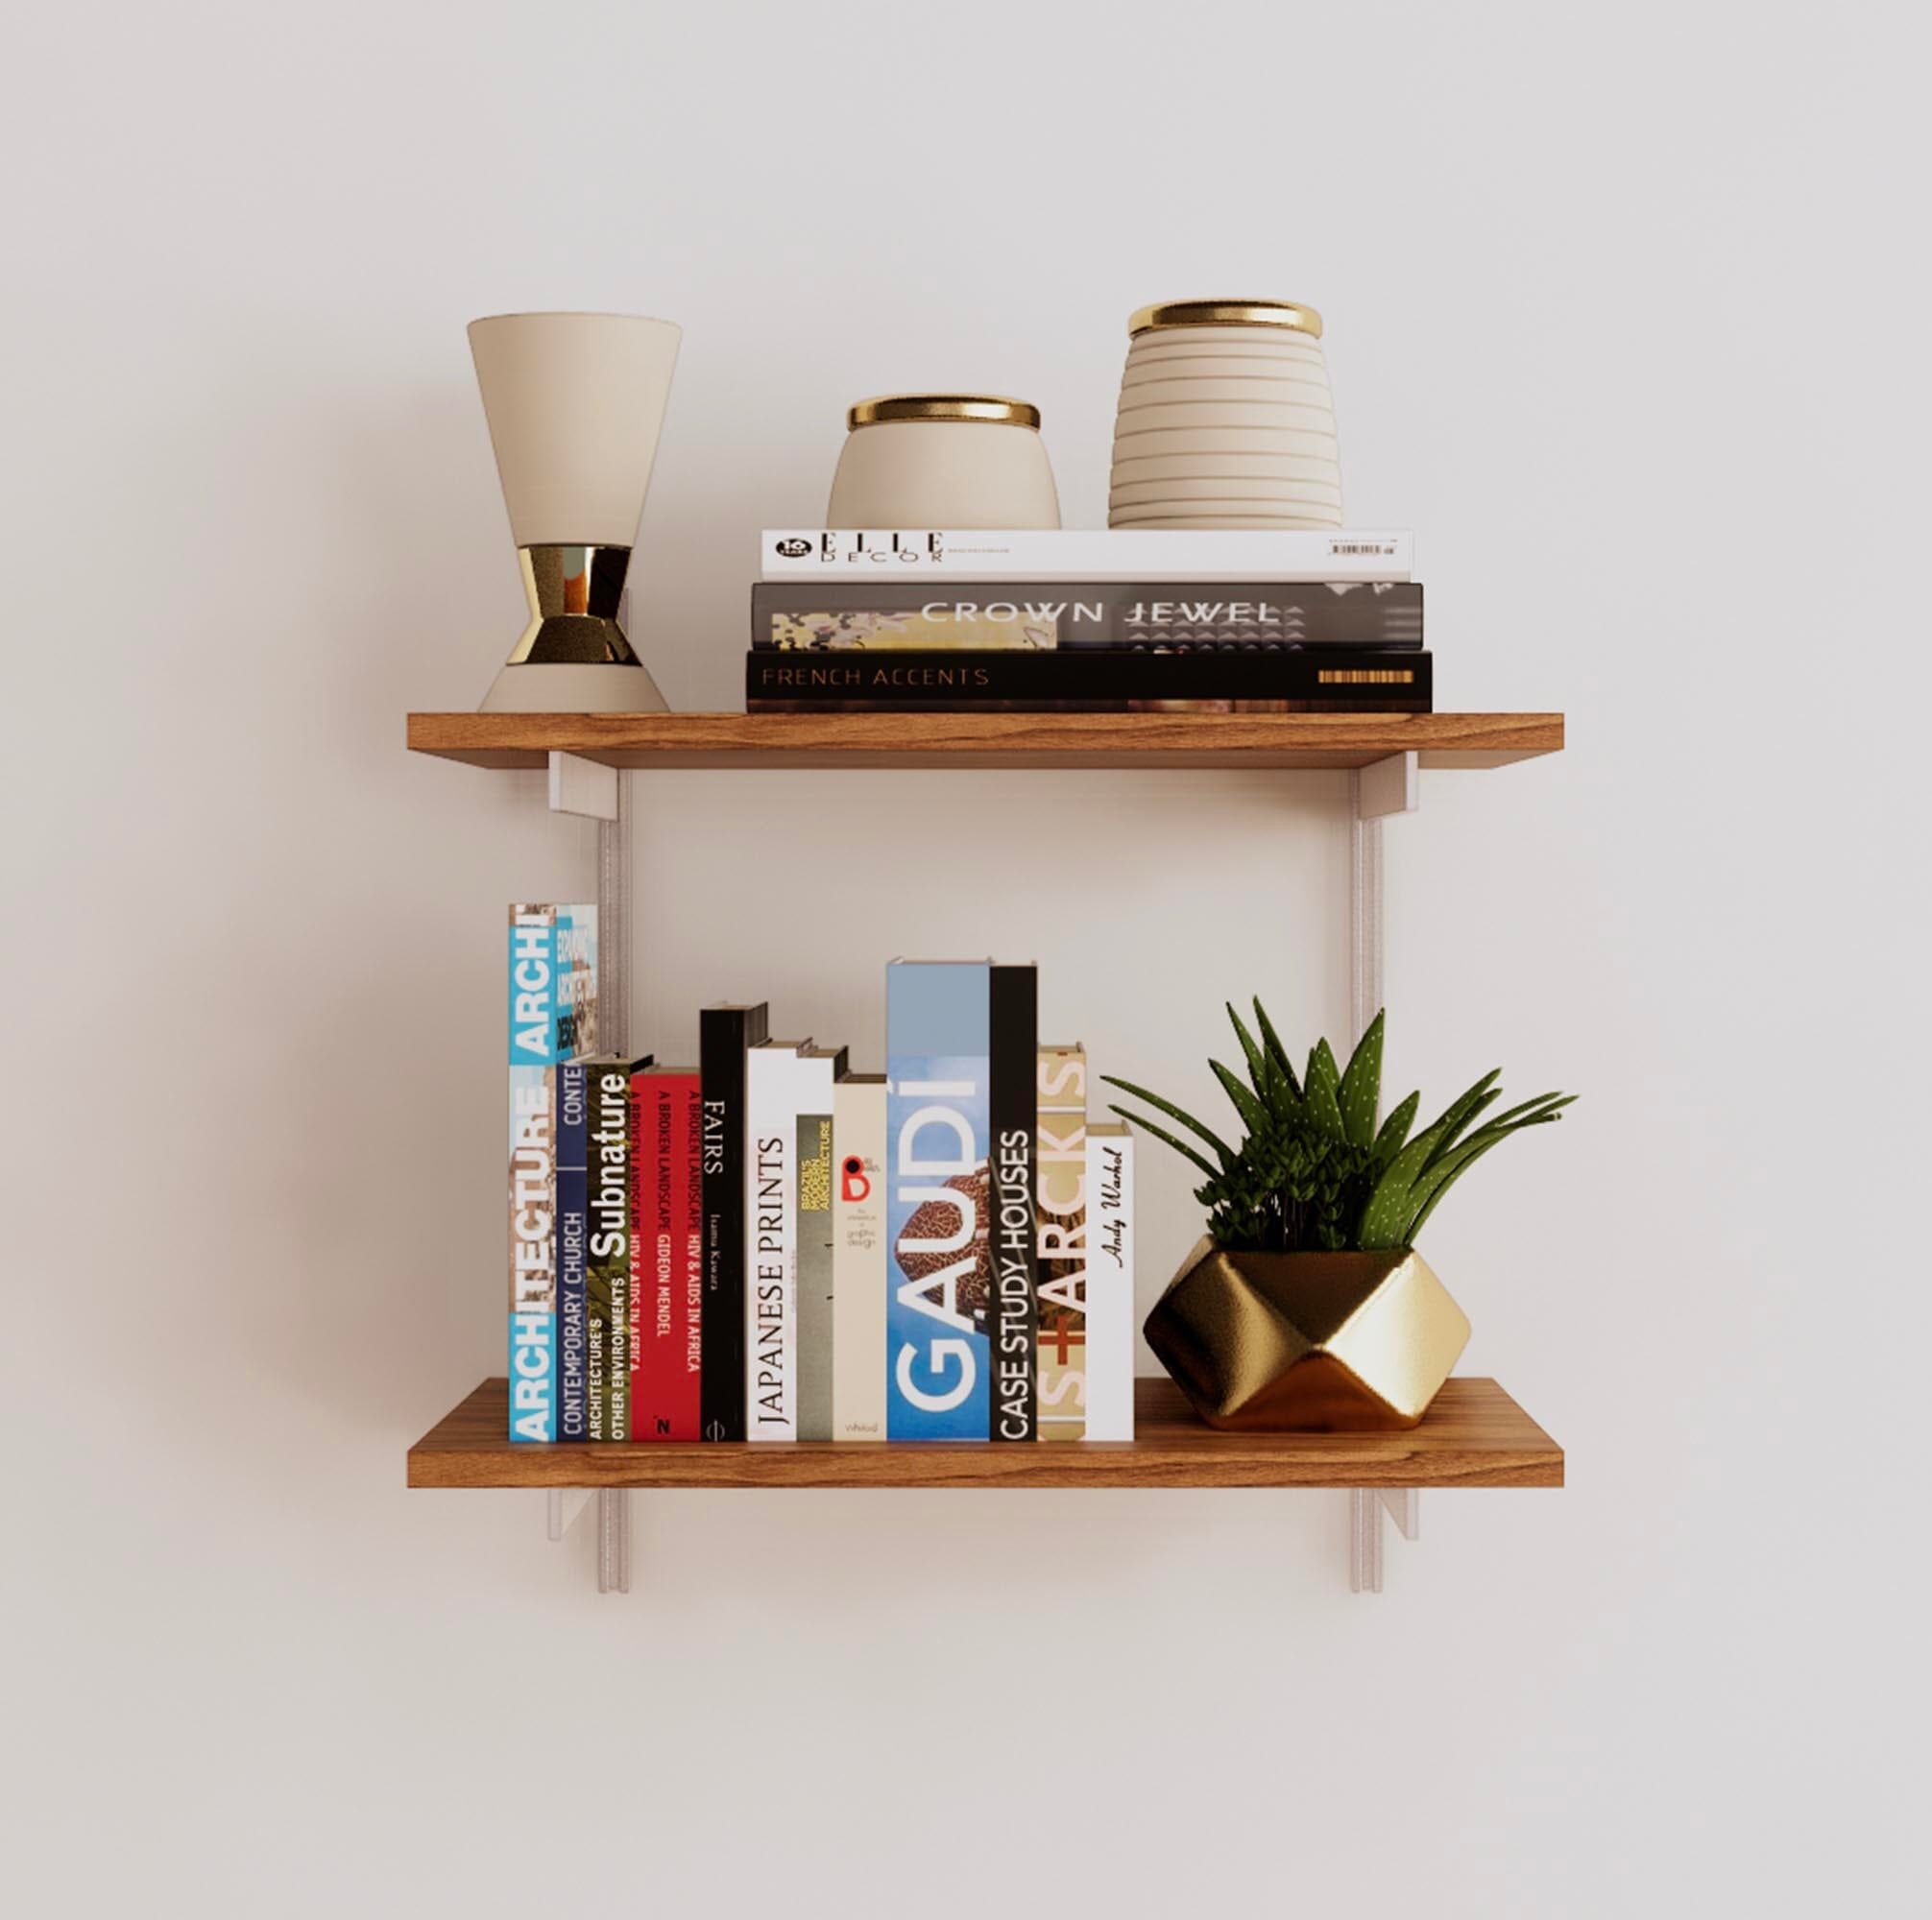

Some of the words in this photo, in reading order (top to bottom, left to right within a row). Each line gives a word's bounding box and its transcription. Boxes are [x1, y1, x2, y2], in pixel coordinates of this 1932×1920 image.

[821, 533, 944, 553] ELLE
[821, 552, 944, 563] DECOR
[921, 602, 1103, 623] CROWN
[1123, 602, 1280, 623] JEWEL
[762, 669, 860, 685] FRENCH
[873, 668, 990, 686] ACCENTS
[515, 904, 550, 1057] ARCHI
[564, 1063, 583, 1126] CONTE
[658, 1091, 671, 1100] A
[688, 1091, 701, 1100] A
[658, 1104, 671, 1154] BROKEN
[688, 1104, 701, 1154] BROKEN
[703, 1101, 726, 1175] FAIRS
[590, 1072, 626, 1258] Subnature
[658, 1158, 671, 1231] LANDSCAPE
[688, 1158, 701, 1231] LANDSCAPE
[758, 1138, 784, 1254] PRINTS
[1001, 1130, 1028, 1249] HOUSES
[1101, 1146, 1123, 1210] Warhol
[514, 1086, 551, 1441] ARCHITECTURE
[564, 1212, 583, 1284] CHURCH
[657, 1235, 671, 1284] GIDEON
[688, 1235, 701, 1258] HIV
[1101, 1218, 1126, 1268] Andy
[657, 1286, 671, 1337] MENDEL
[688, 1275, 701, 1306] AIDS
[688, 1308, 701, 1323] IN
[1001, 1257, 1028, 1354] STUDY
[564, 1290, 583, 1435] CONTEMPORARY
[612, 1277, 625, 1388] ENVIRONMENTS
[688, 1326, 701, 1373] AFRICA
[758, 1264, 790, 1425] JAPANESE
[590, 1317, 603, 1440] ARCHITECTURE'S
[1001, 1361, 1028, 1439] CASE
[612, 1392, 625, 1440] OTHER
